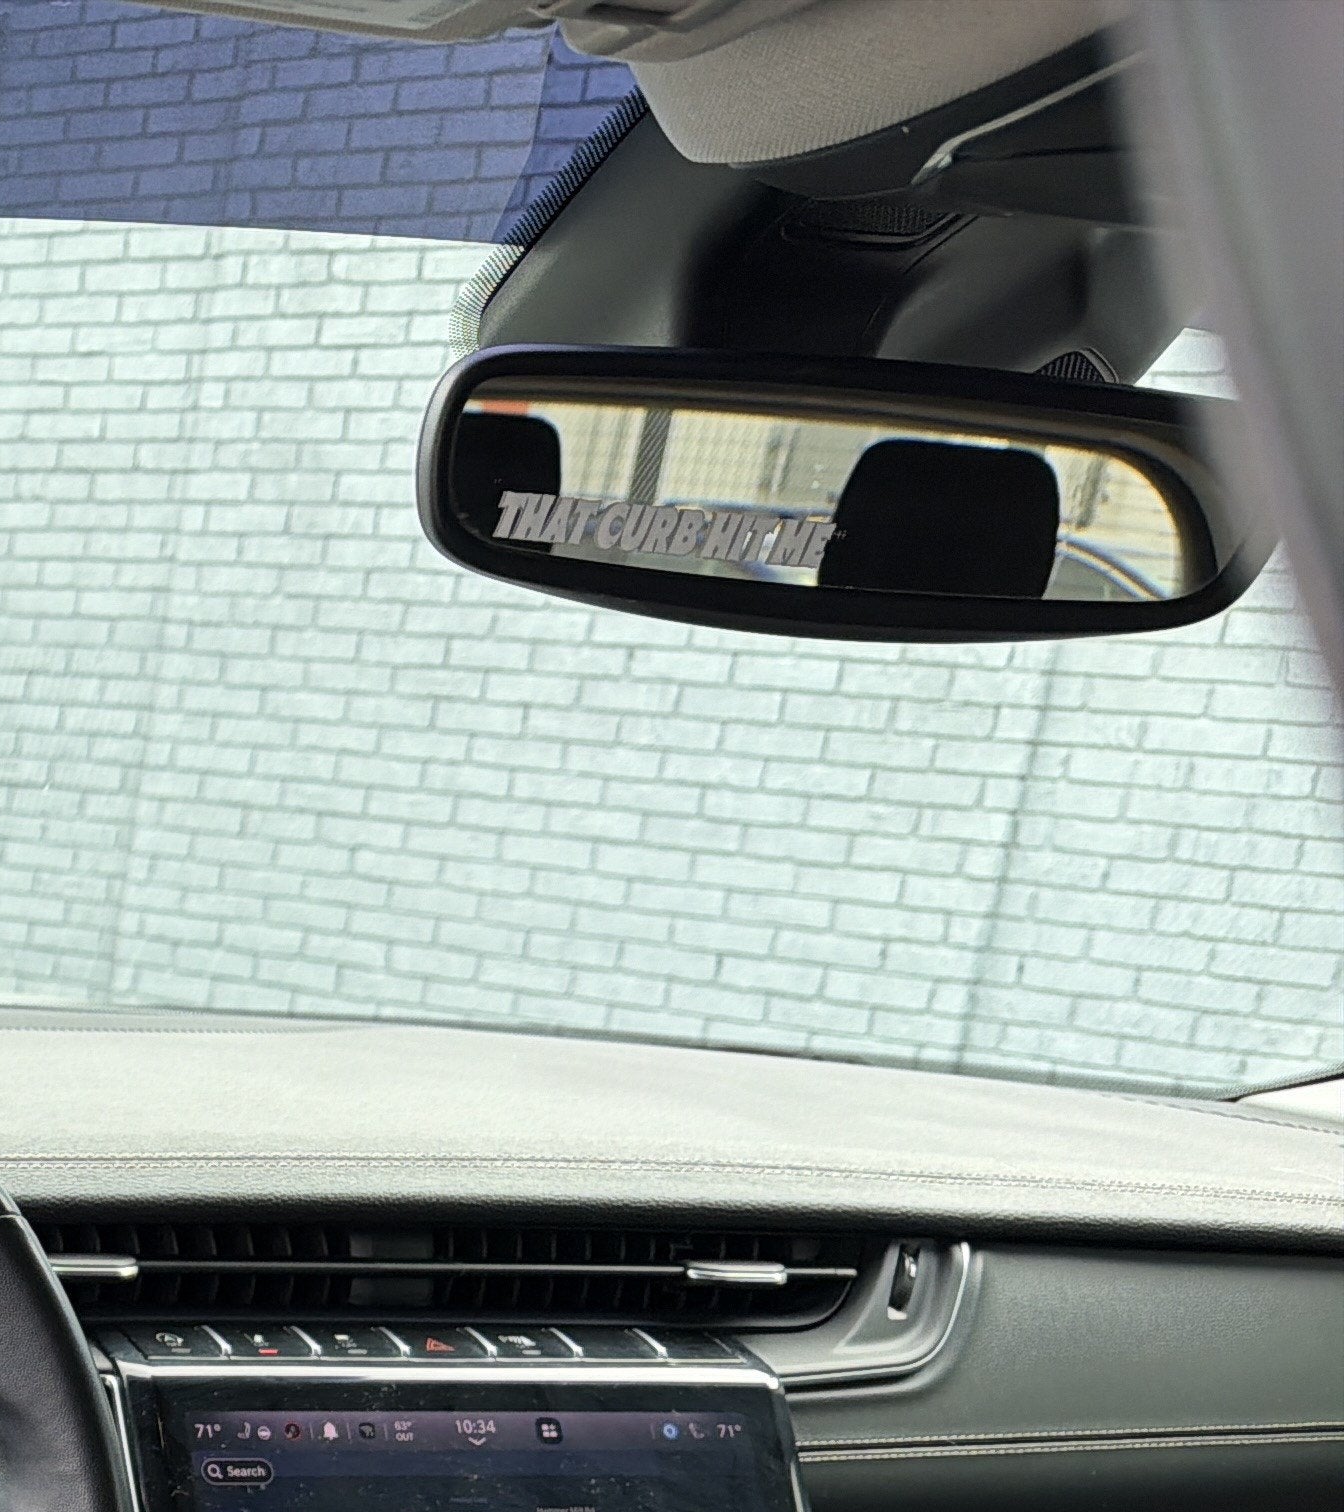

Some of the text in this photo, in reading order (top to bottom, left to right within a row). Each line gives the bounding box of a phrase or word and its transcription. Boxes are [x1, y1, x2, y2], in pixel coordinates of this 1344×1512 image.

[492, 490, 837, 569] THAT CURB HIT ME
[455, 1419, 497, 1435] 10:34
[395, 1432, 414, 1443] OUT
[226, 1465, 267, 1478] Search
